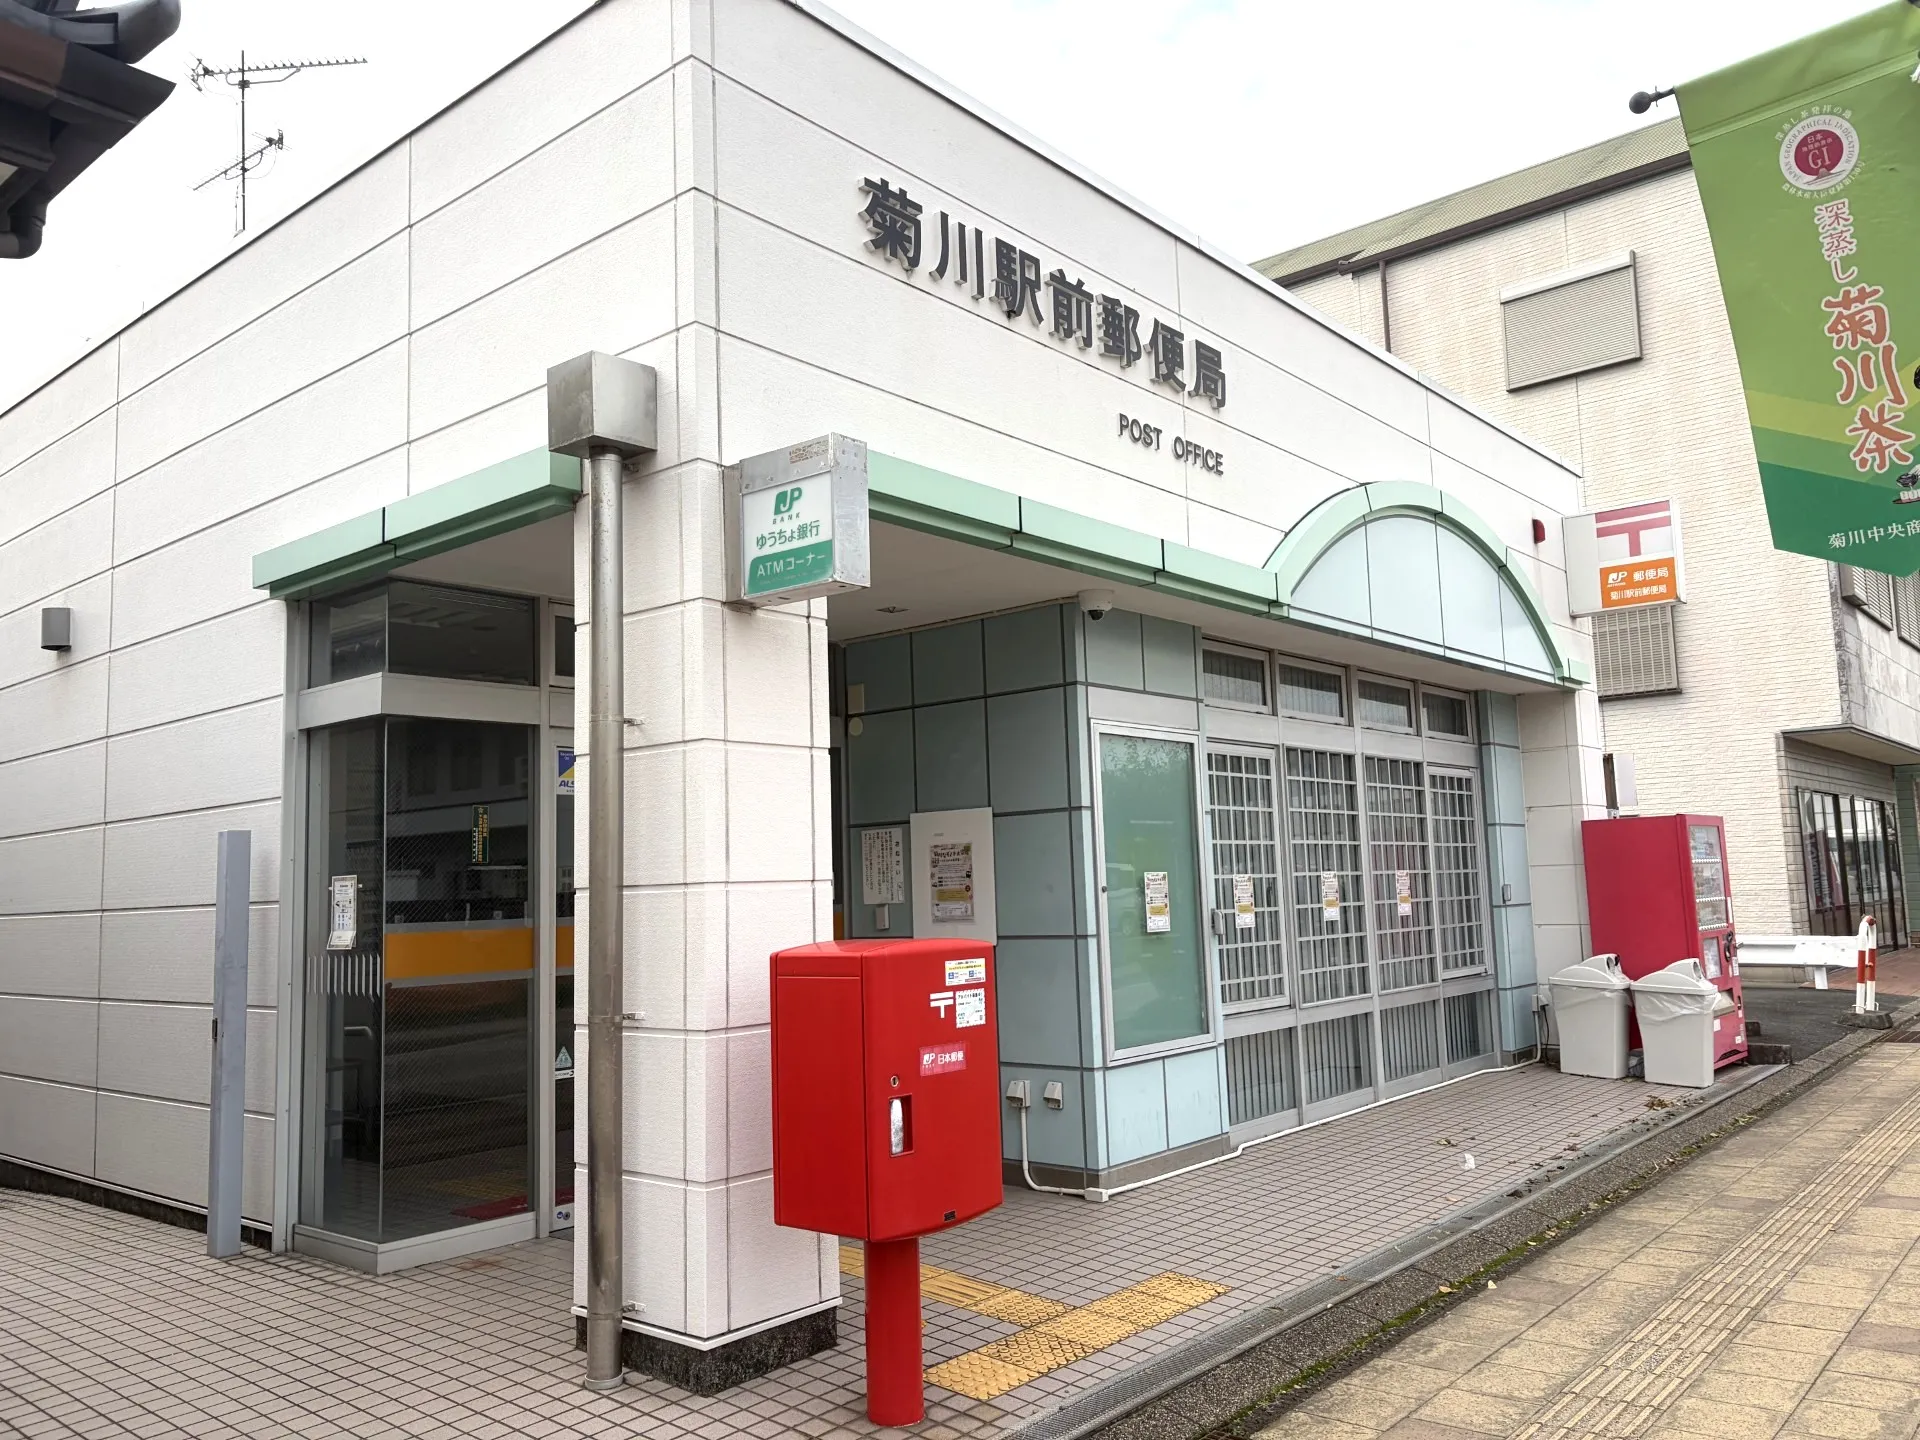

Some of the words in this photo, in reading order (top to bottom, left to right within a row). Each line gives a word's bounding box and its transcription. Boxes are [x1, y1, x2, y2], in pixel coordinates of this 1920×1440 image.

[1807, 133, 1823, 144] 日本
[1808, 147, 1831, 169] GI
[858, 177, 1227, 410] 菊川駅前郵便局
[1118, 412, 1162, 451] POST
[1171, 435, 1224, 477] OFFICE
[772, 511, 801, 525] BANK
[756, 519, 820, 550] ゆうちょ銀行
[1827, 519, 1920, 549] 菊川中央商
[757, 552, 826, 577] ATMコーナー
[1633, 566, 1669, 582] 郵便局
[937, 1050, 964, 1065] 日本郵便
